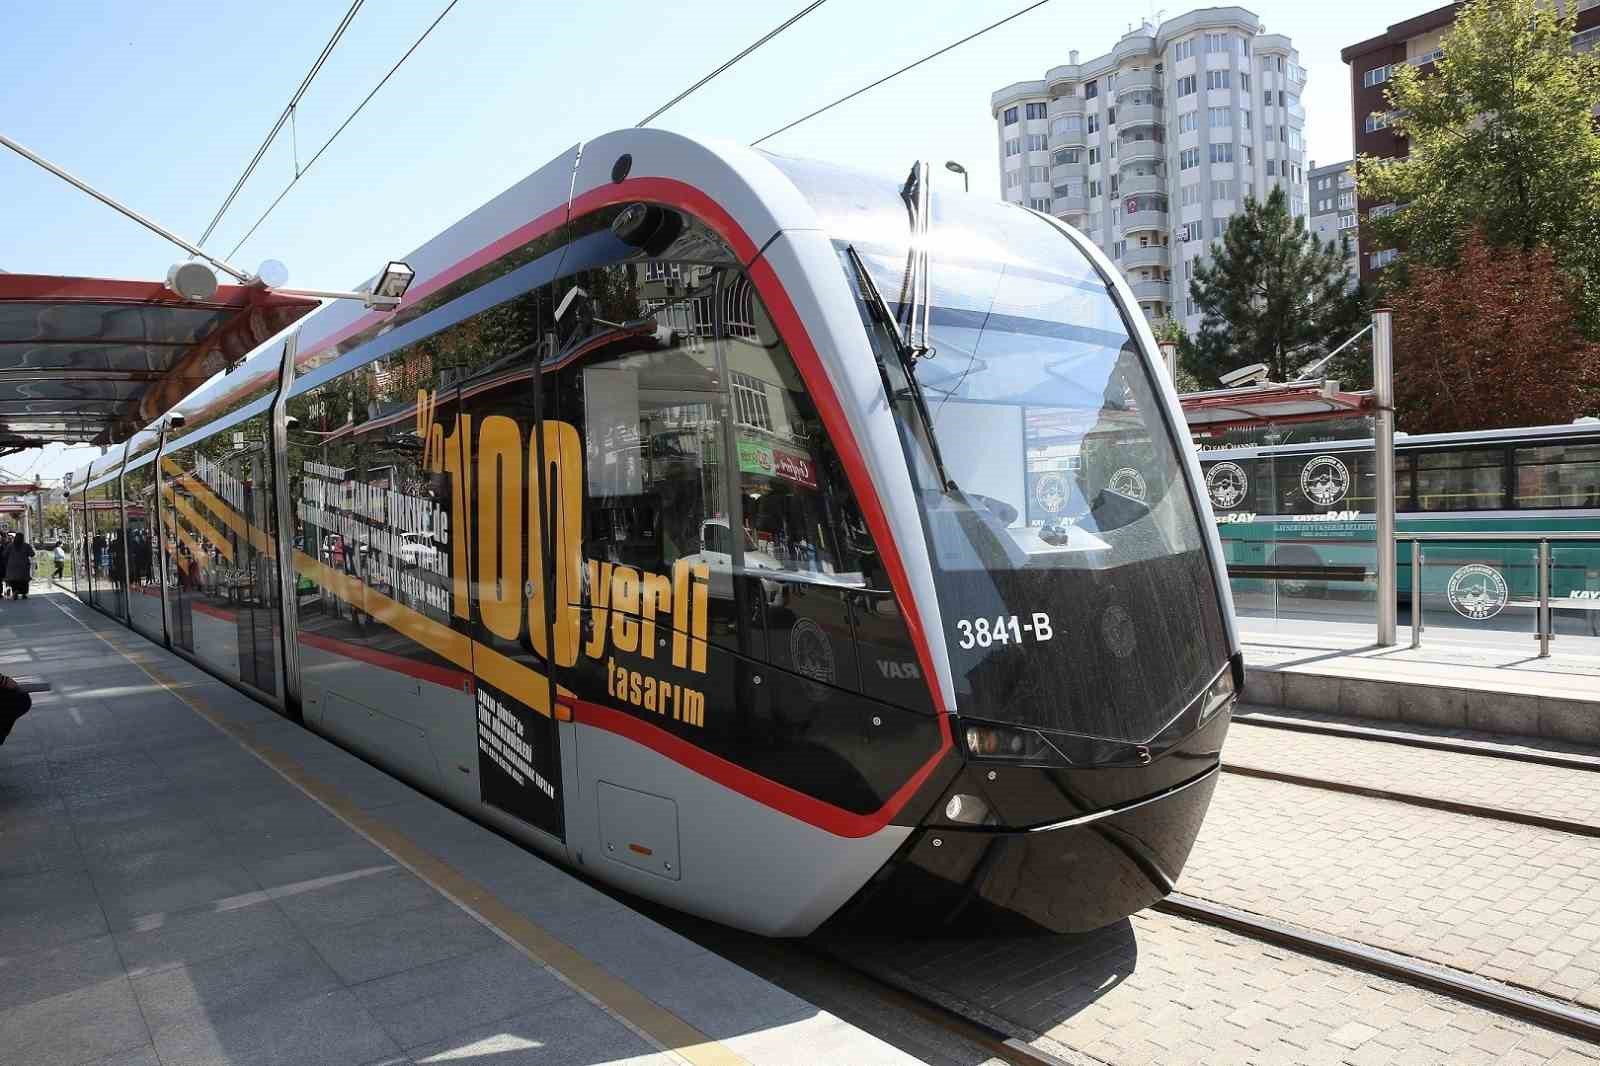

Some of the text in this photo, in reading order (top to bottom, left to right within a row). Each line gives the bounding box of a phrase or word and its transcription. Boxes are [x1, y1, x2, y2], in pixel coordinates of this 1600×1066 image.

[416, 388, 583, 668] %100
[585, 557, 711, 675] yerli
[956, 611, 1054, 651] 3841-B
[1569, 589, 1600, 600] KAY
[606, 655, 706, 729] tasarım
